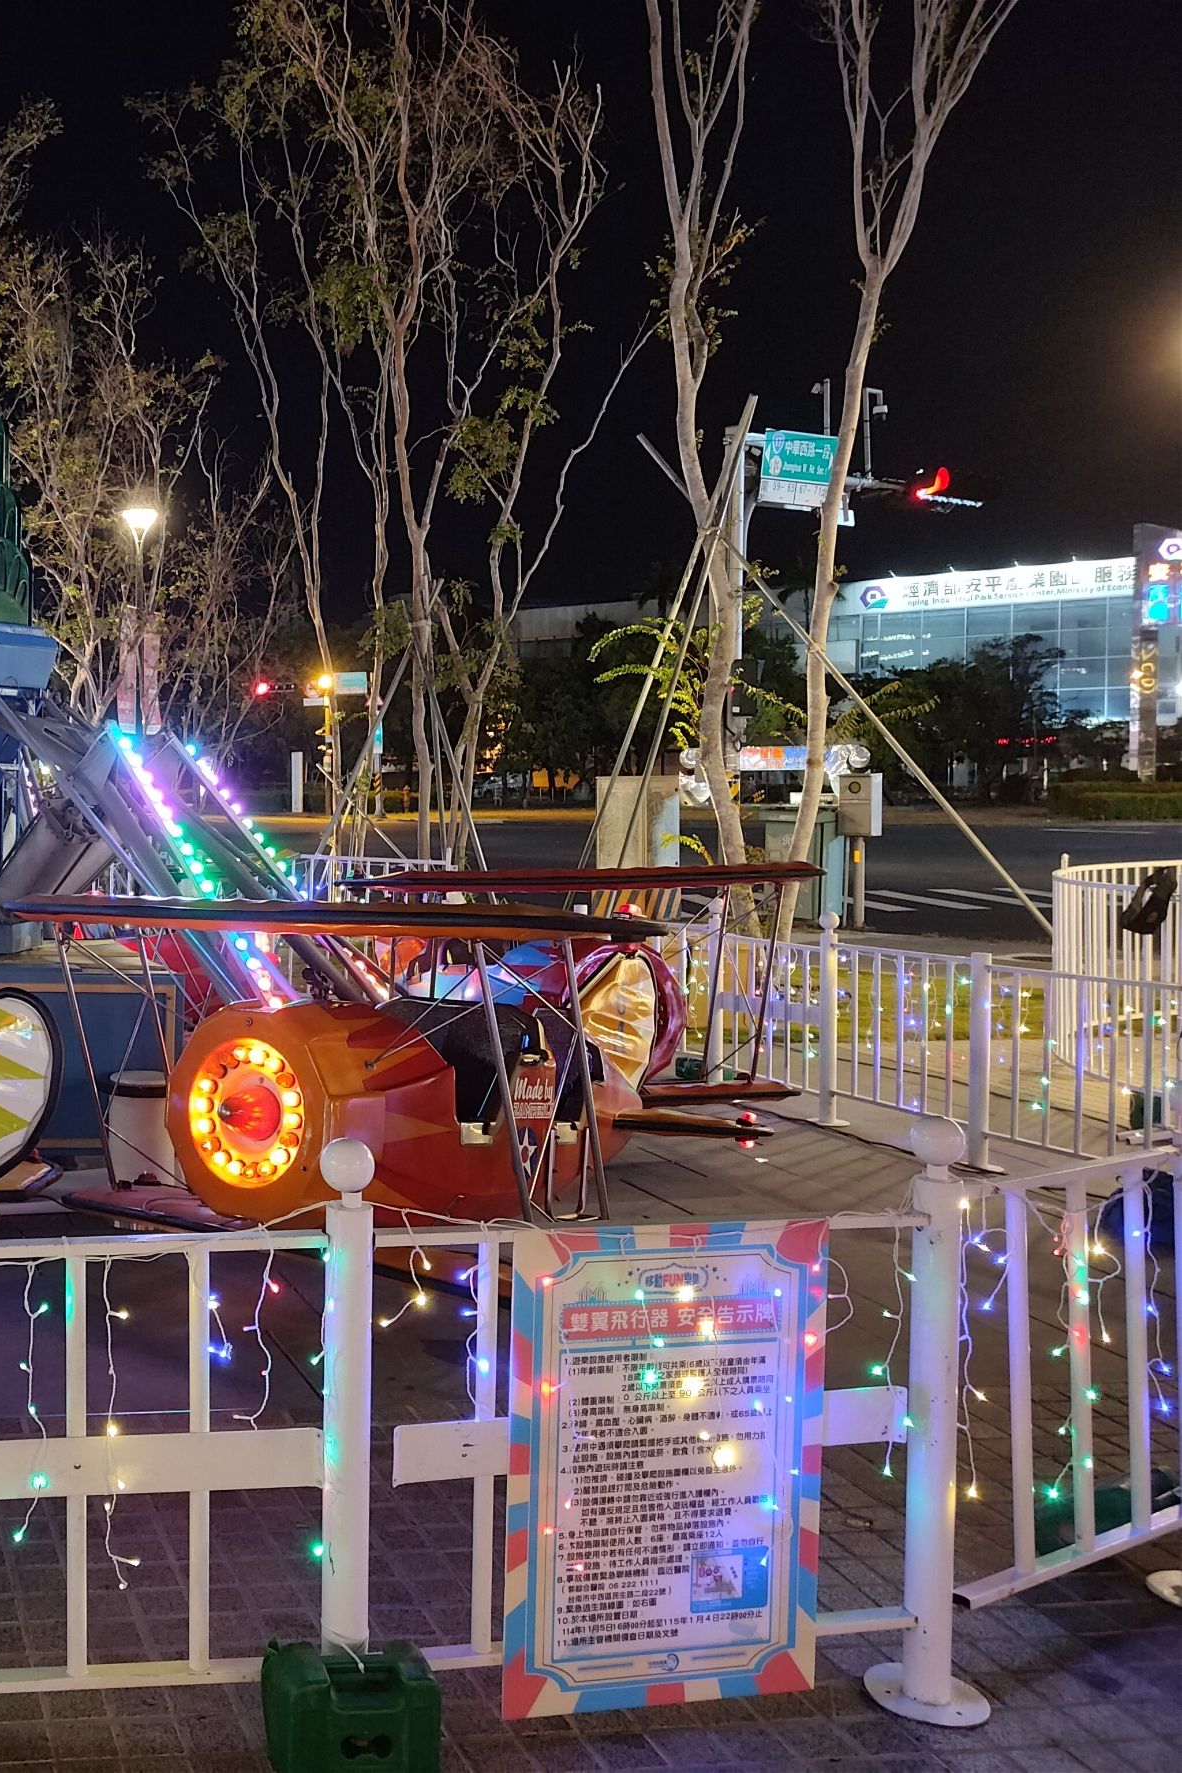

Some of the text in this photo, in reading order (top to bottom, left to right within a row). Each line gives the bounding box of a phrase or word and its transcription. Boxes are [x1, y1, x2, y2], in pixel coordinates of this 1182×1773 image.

[784, 439, 831, 460] 中華西路一段
[514, 1076, 554, 1106] Made by
[570, 1302, 774, 1333] 雙翼飛行器 安全告示牌
[608, 1582, 619, 1590] 06
[621, 1580, 636, 1589] 222
[640, 1579, 659, 1587] 1111
